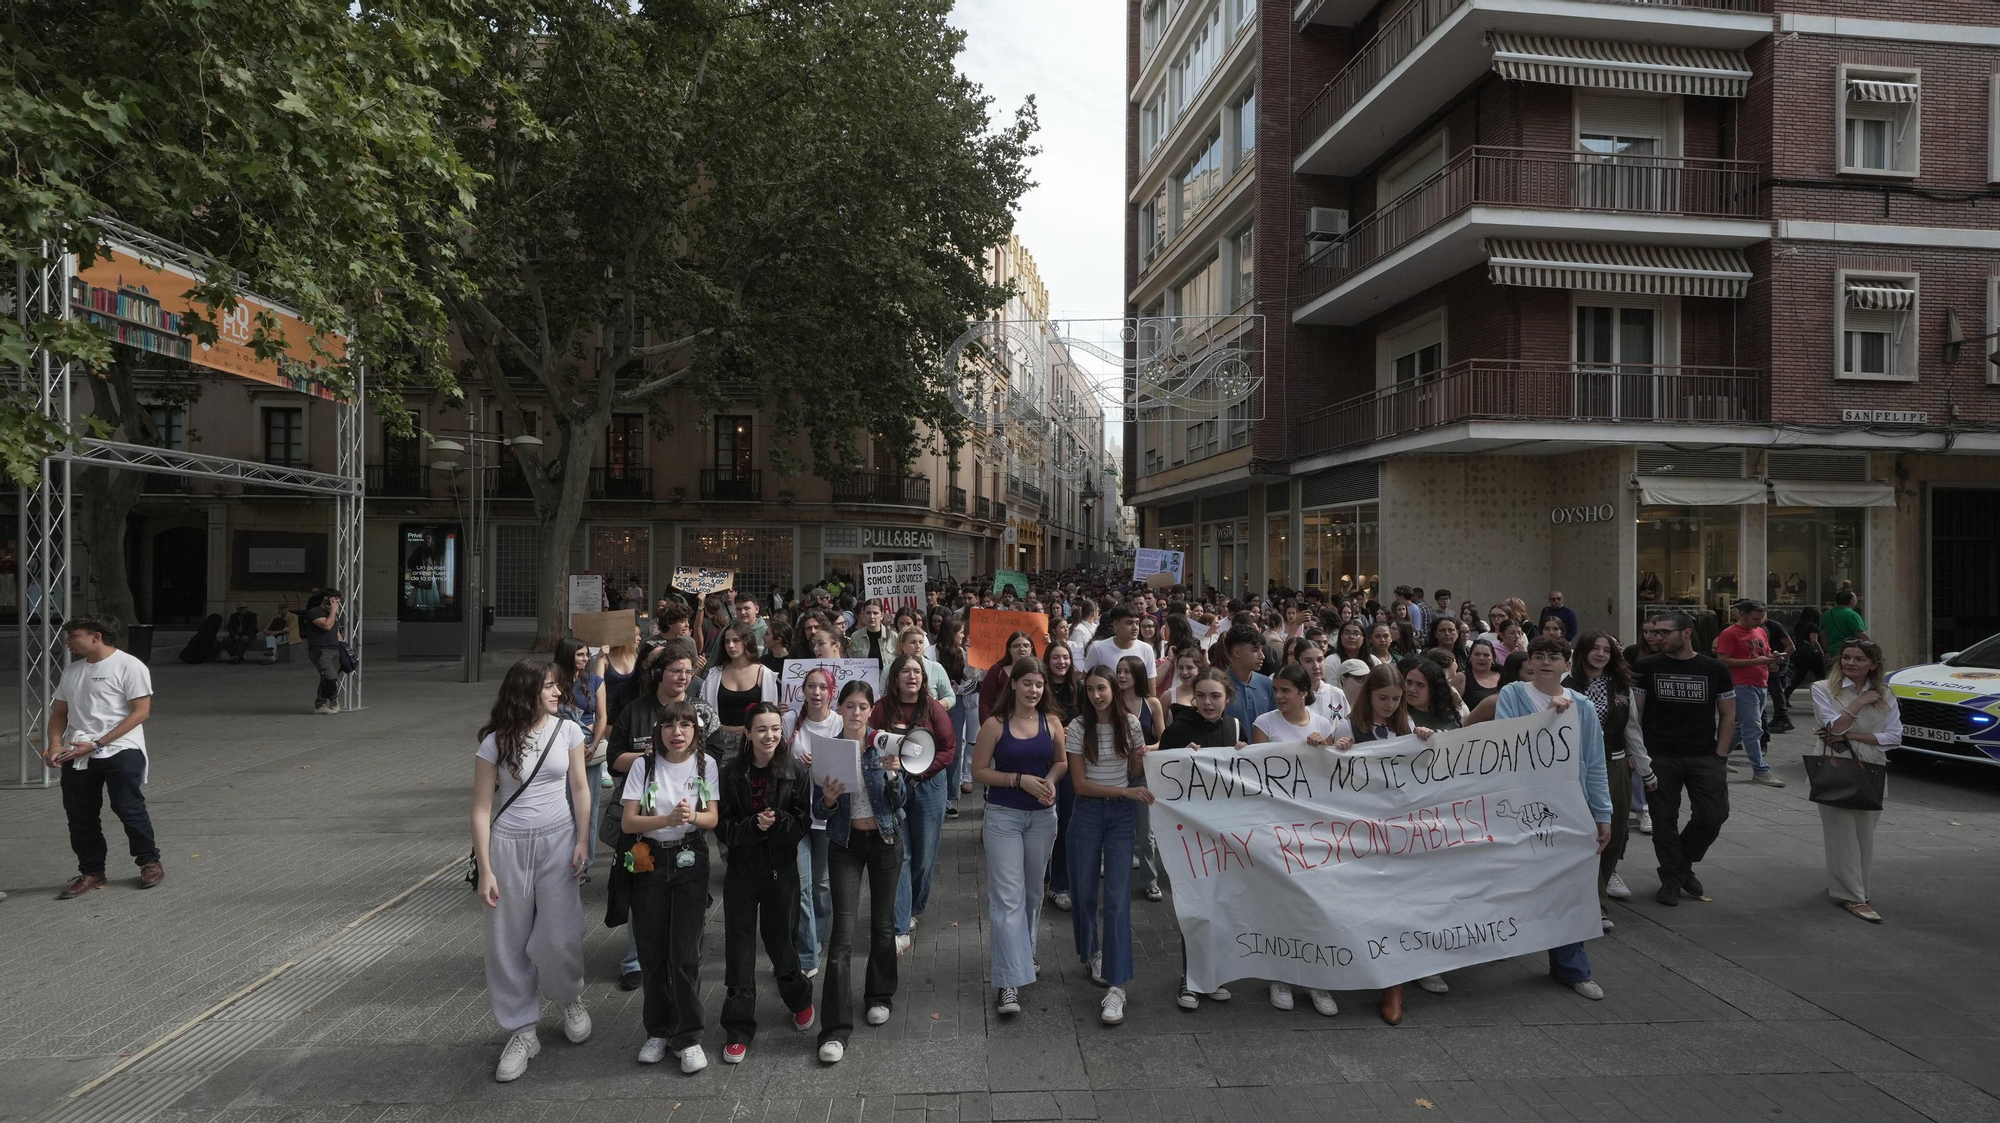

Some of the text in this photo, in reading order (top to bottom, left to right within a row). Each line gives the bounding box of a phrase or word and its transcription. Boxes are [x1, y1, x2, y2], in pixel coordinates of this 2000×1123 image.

[1845, 411, 1926, 422] SAN FELIPE
[1551, 503, 1614, 524] OYSHO
[863, 528, 935, 548] PULL&BEAR
[676, 566, 692, 575] POR
[866, 563, 922, 575] TODOS JUNTOS
[867, 573, 923, 586] SOMOS LAS VOCES
[873, 584, 916, 596] DE LOS QUE
[1660, 681, 1703, 691] LIVE TO RIDE
[1660, 689, 1703, 699] RIDE TO LIVE
[1928, 730, 1951, 741] MSD
[1161, 725, 1573, 801] SANDRA NO TE OLVIDAMOS
[1176, 795, 1495, 879] ¡HAY RESPONSABLES!
[1235, 917, 1518, 966] SINDICATO DE ESTUDIANTES
